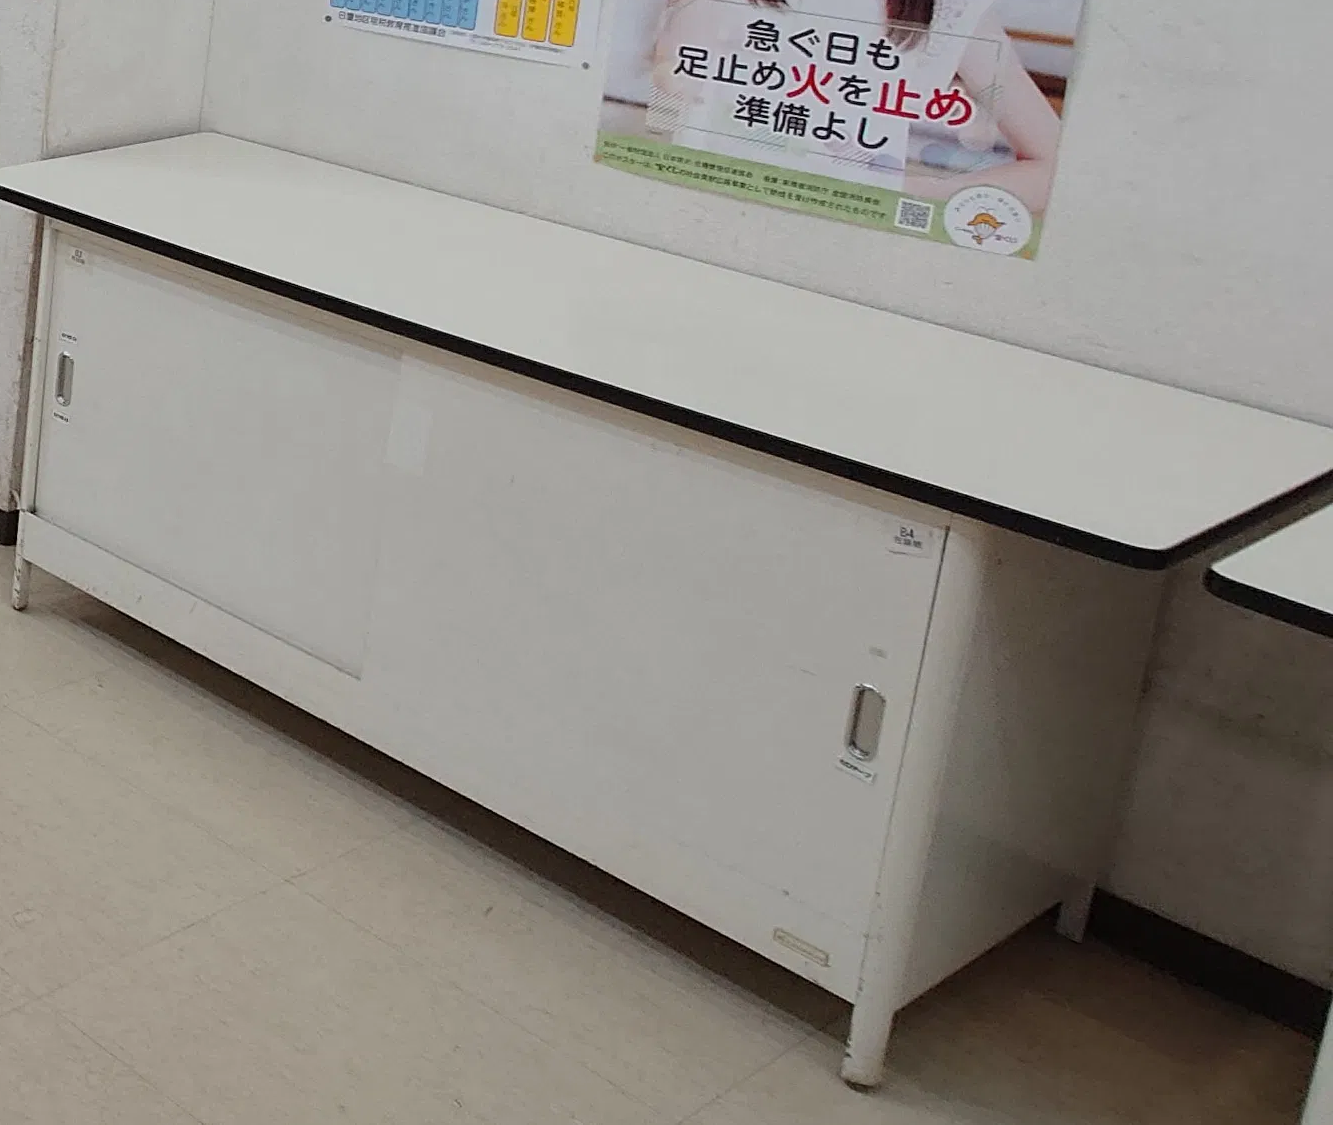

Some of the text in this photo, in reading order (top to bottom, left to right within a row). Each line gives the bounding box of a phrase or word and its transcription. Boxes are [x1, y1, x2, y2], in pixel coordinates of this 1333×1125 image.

[744, 19, 900, 71] 急ぐ日も
[673, 45, 973, 126] 足止め火を止め
[733, 93, 890, 150] 準備よし
